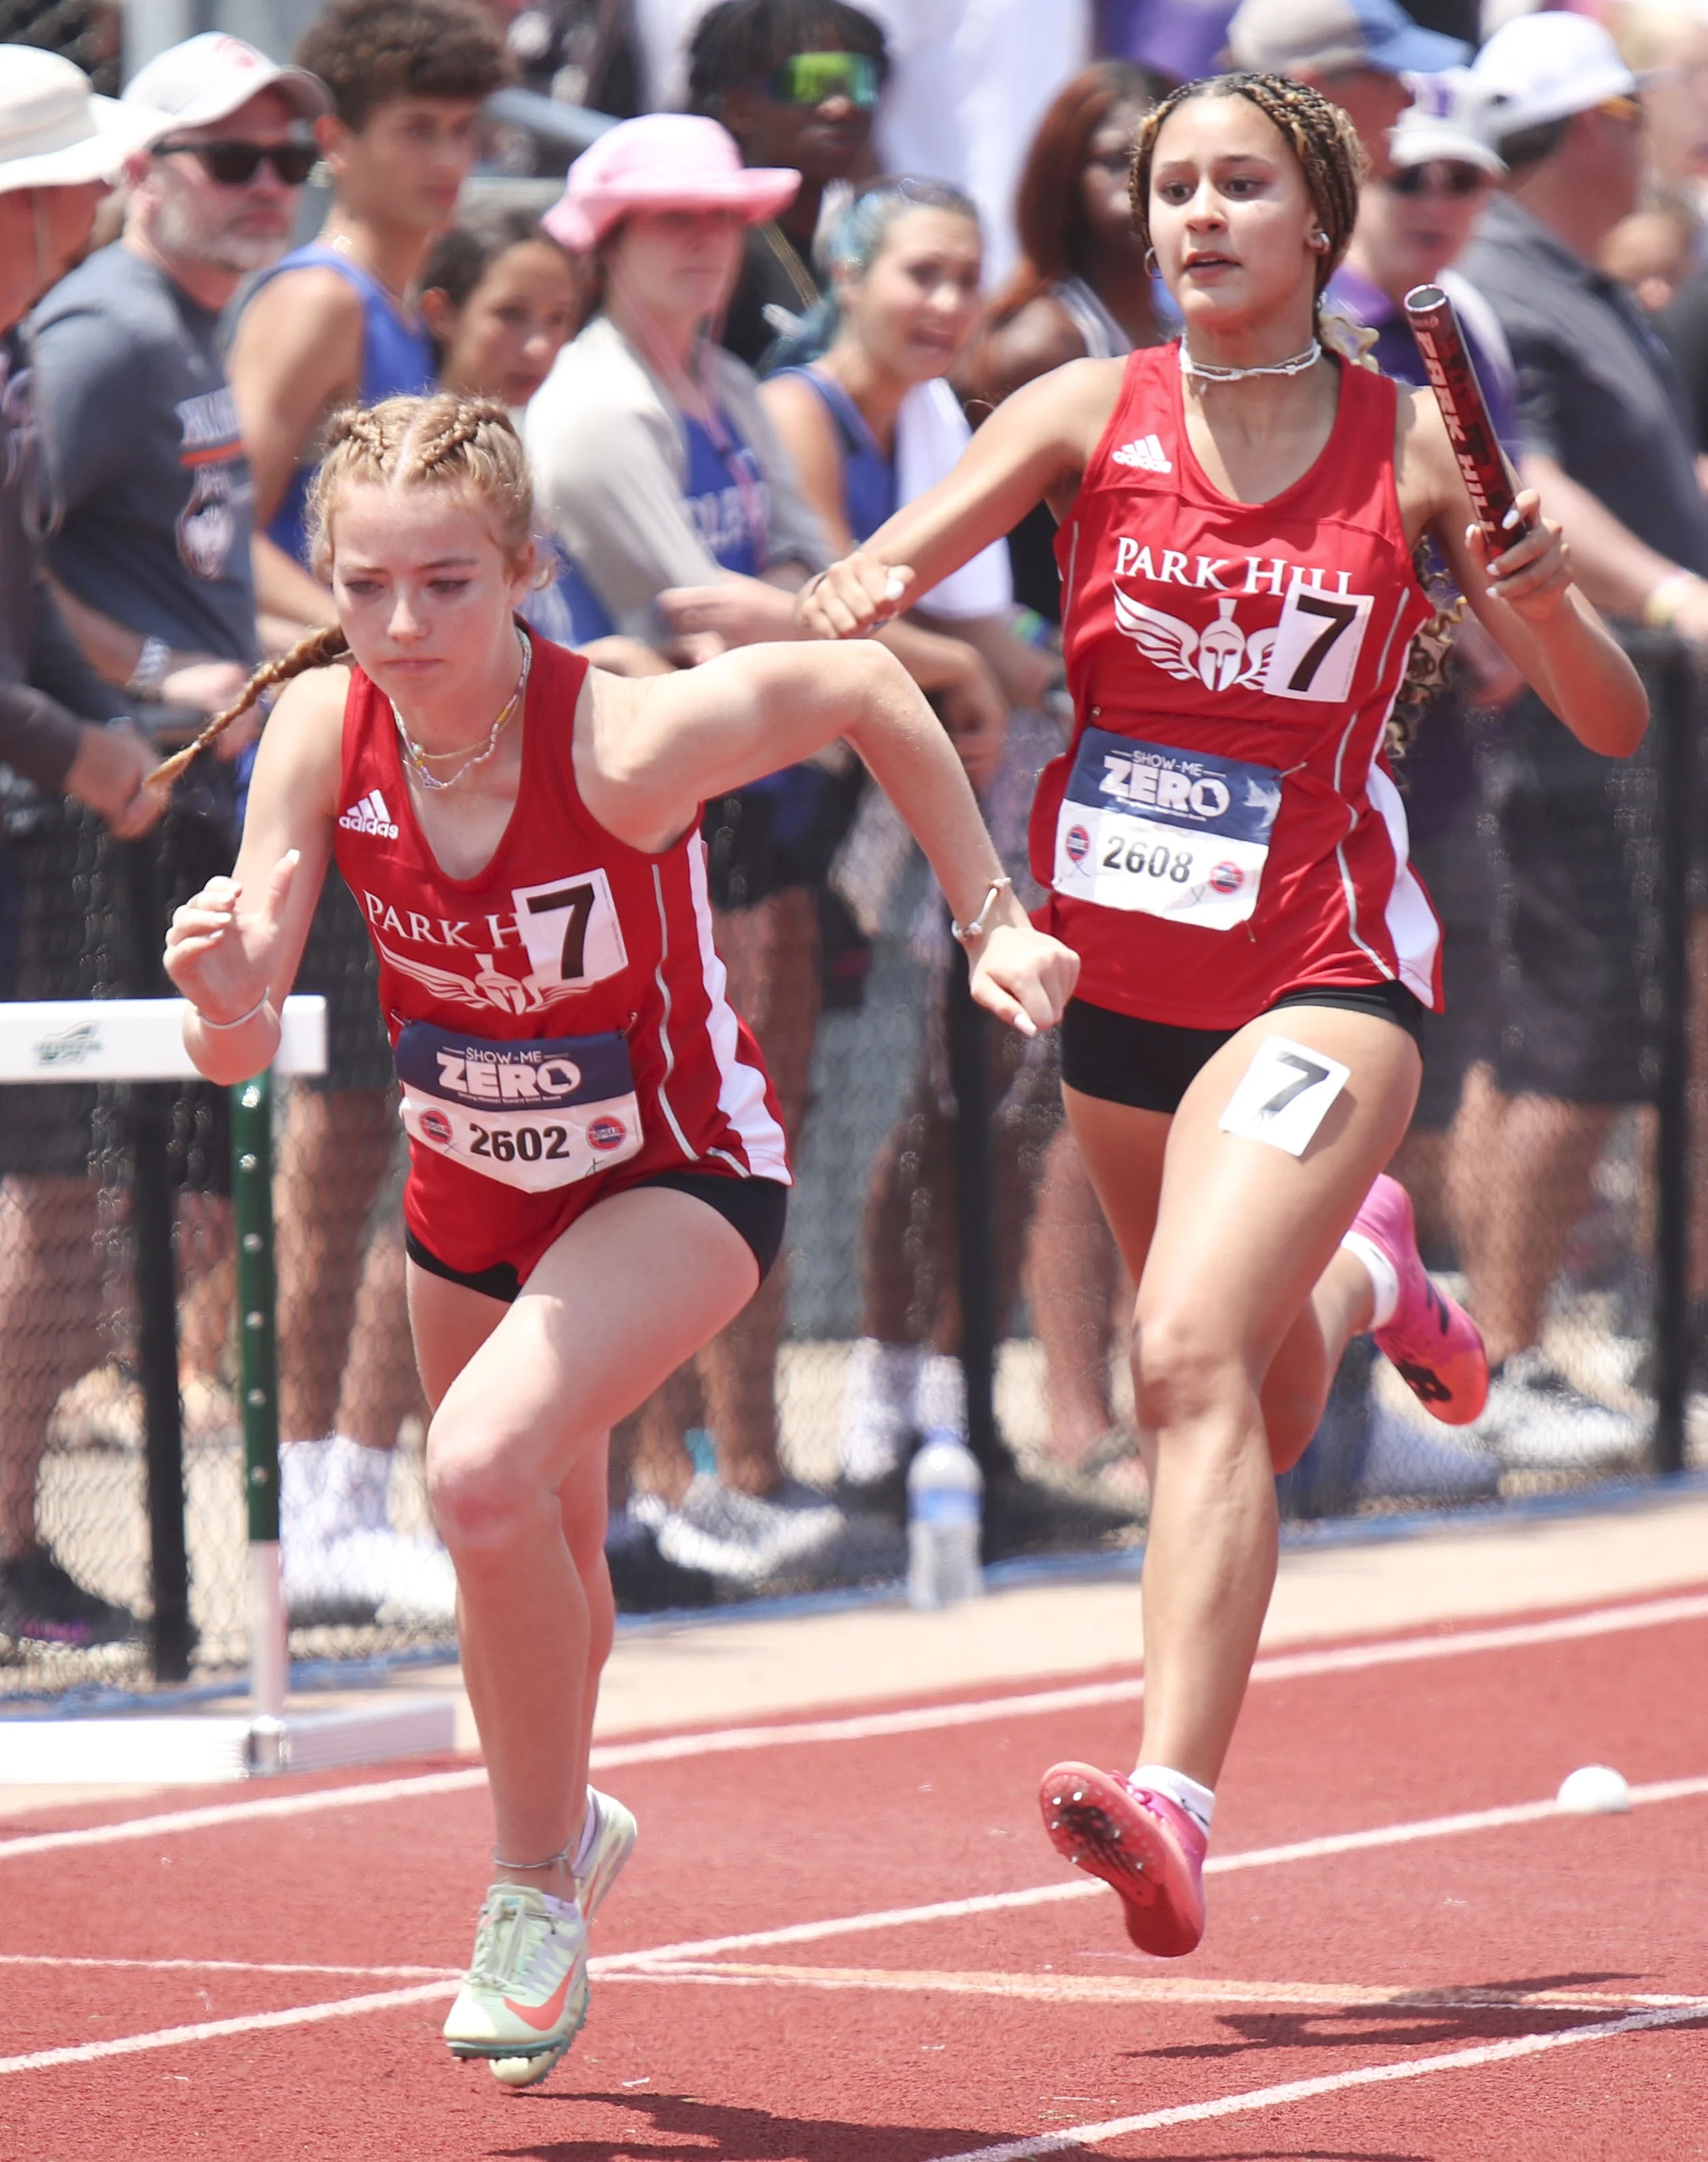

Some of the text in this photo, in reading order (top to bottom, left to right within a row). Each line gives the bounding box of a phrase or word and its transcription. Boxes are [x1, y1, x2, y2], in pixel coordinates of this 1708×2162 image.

[1415, 331, 1467, 441] PARK
[1112, 451, 1173, 473] adidas
[1114, 536, 1230, 592] PARK
[1287, 594, 1359, 693] 7
[1099, 755, 1230, 817] ZERO
[1132, 750, 1204, 777] SHOW-ME
[338, 816, 399, 840] adidas
[1102, 835, 1194, 883] 2608
[362, 889, 480, 949] PARK
[526, 883, 596, 980] 7
[436, 1051, 581, 1098] ZERO
[465, 1047, 542, 1064] SHOW-ME
[1257, 1050, 1331, 1120] 7
[469, 1122, 570, 1162] 2602
